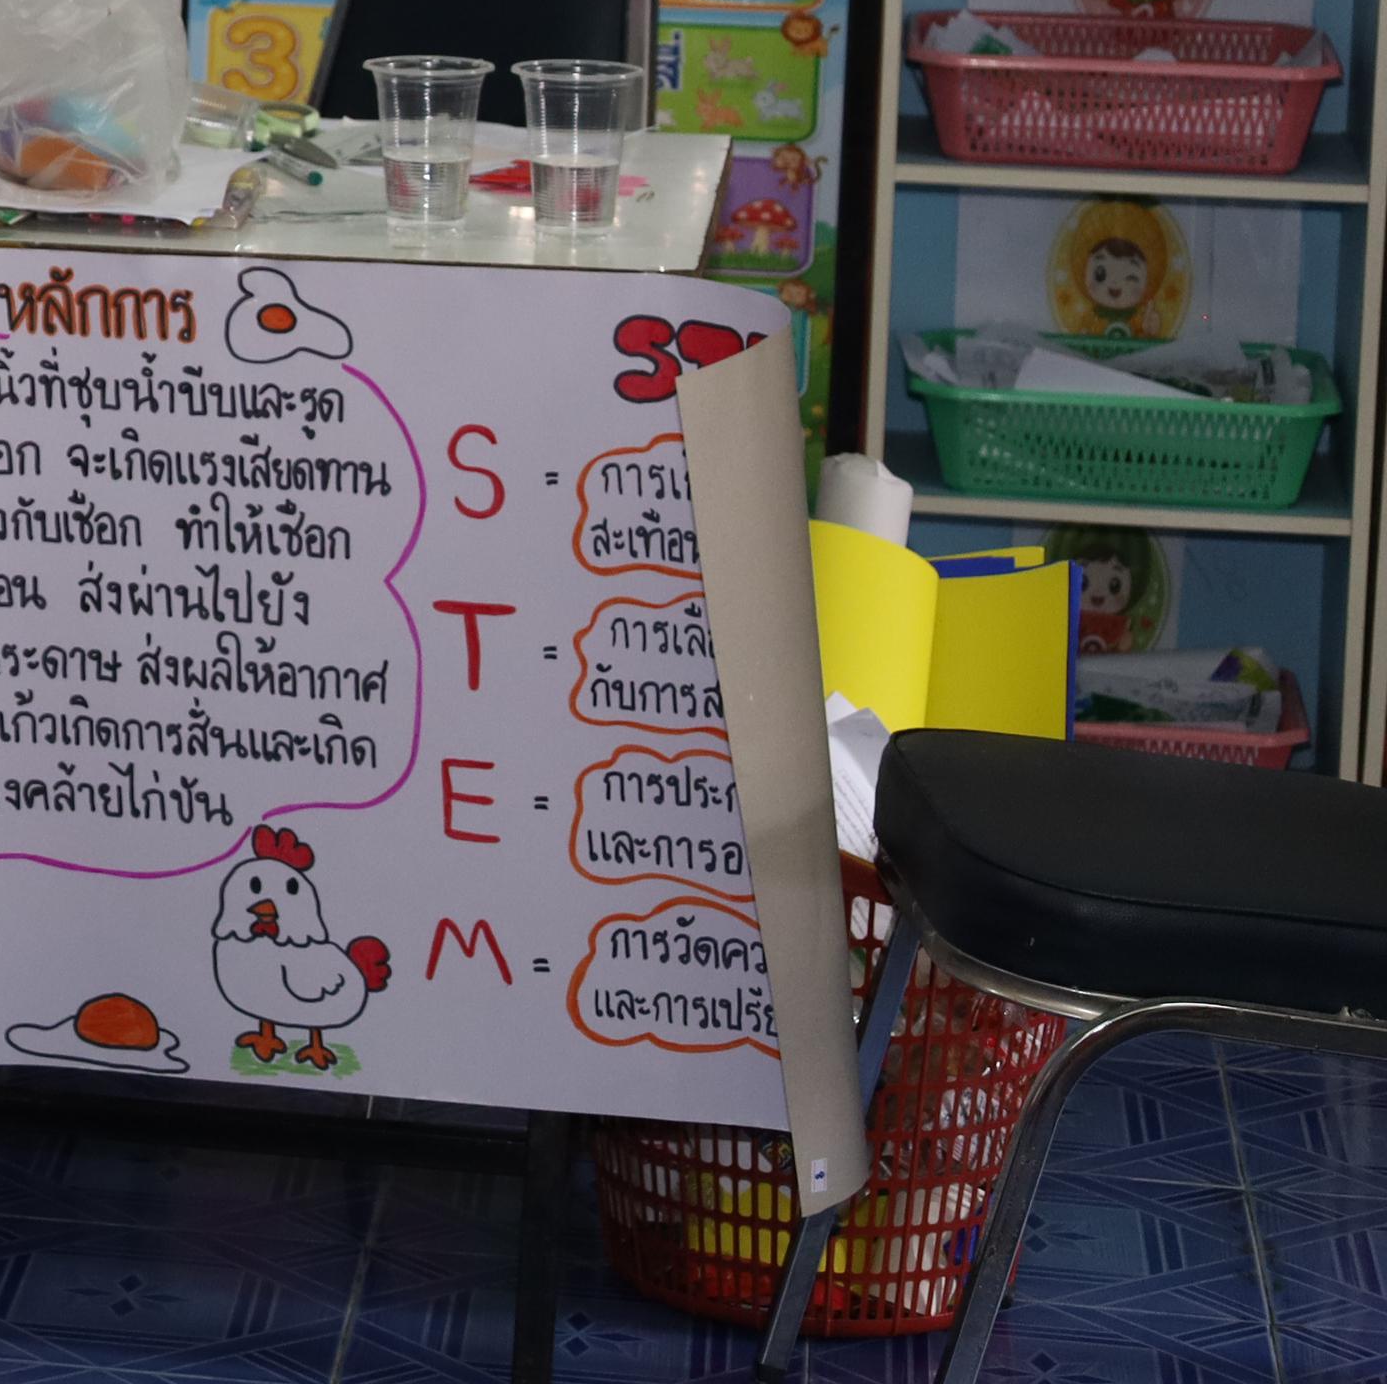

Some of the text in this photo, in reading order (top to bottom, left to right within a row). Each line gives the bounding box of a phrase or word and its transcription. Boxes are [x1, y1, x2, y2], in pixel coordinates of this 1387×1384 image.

[221, 17, 301, 103] 3
[66, 427, 393, 498] จะเกิดแรงเสียดทาน
[446, 423, 506, 520] S
[174, 492, 352, 560] ทำให้เชือก
[77, 562, 311, 628] ส่งผ่านไปยัง
[136, 631, 390, 705] ส่งผลให้อากาศ
[432, 598, 517, 692] T
[610, 602, 715, 662] การเลื
[441, 758, 502, 844] E
[427, 917, 513, 986] M
